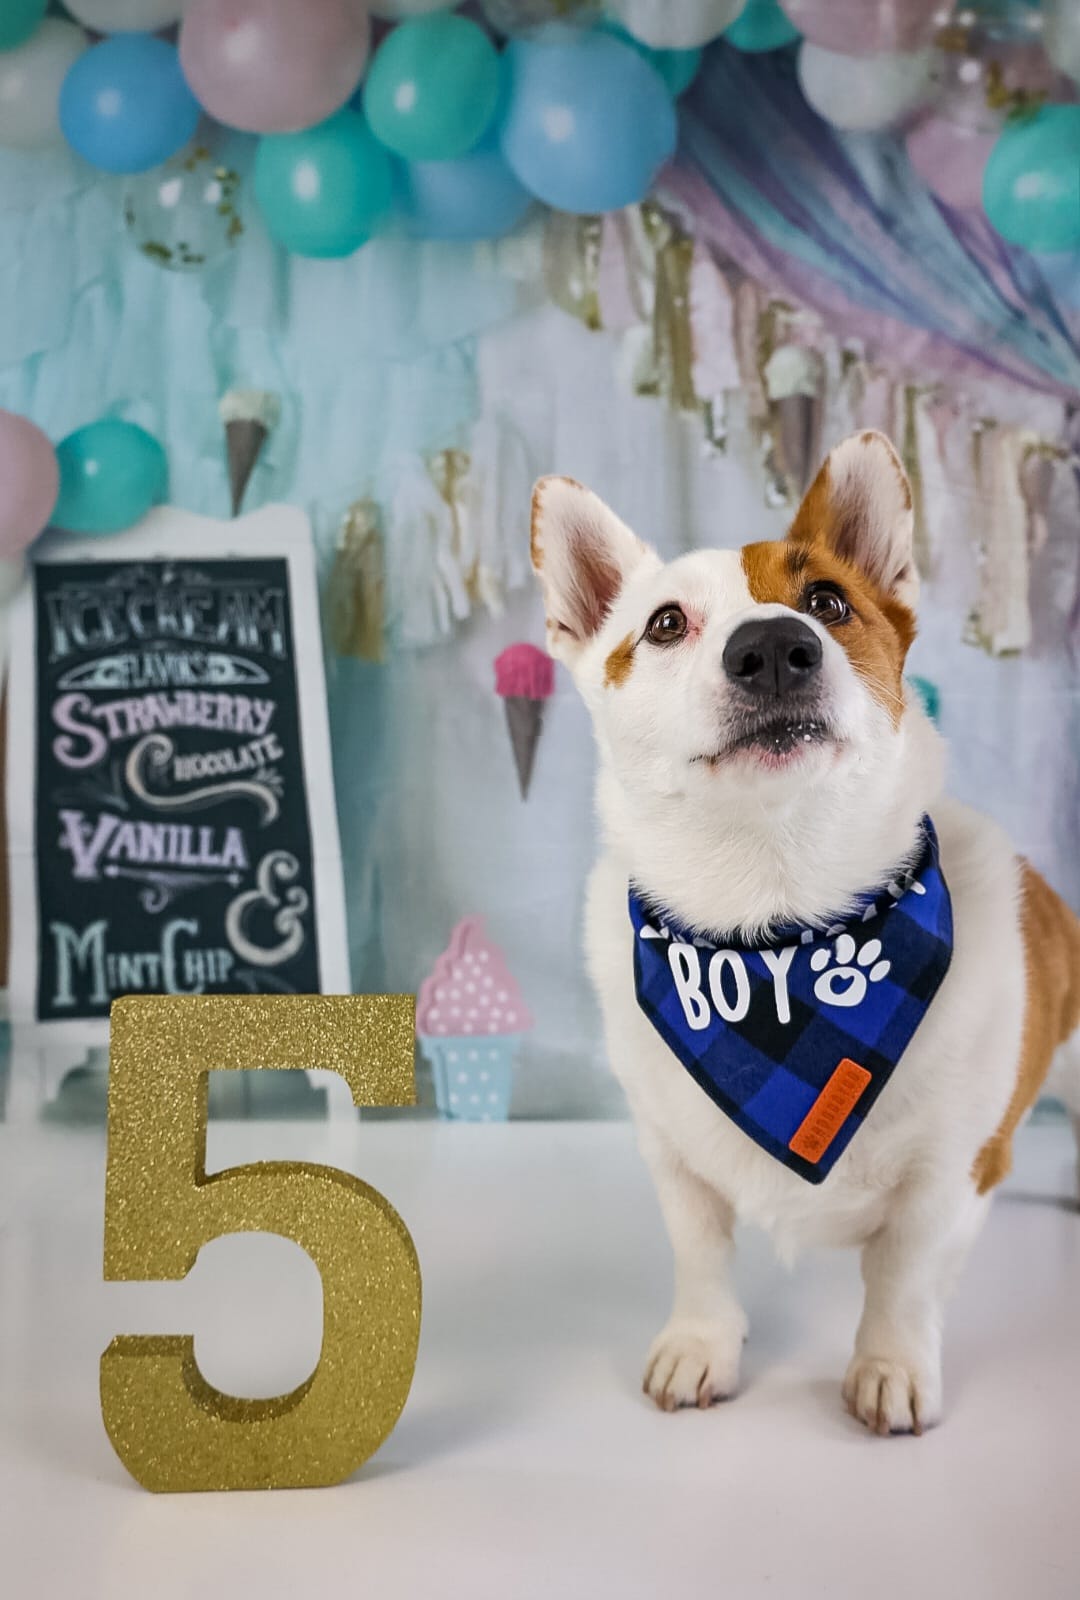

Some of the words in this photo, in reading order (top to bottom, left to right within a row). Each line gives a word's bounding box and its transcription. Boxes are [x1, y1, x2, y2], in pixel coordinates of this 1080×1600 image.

[127, 586, 287, 659] CREAM
[53, 690, 275, 768] STRAWBERRY
[126, 733, 283, 826] CHOCOLATE
[58, 809, 249, 879] VANILLA
[50, 919, 163, 1007] MINT
[161, 918, 235, 995] CHIP
[668, 943, 799, 1031] BOY
[100, 994, 422, 1494] 5
